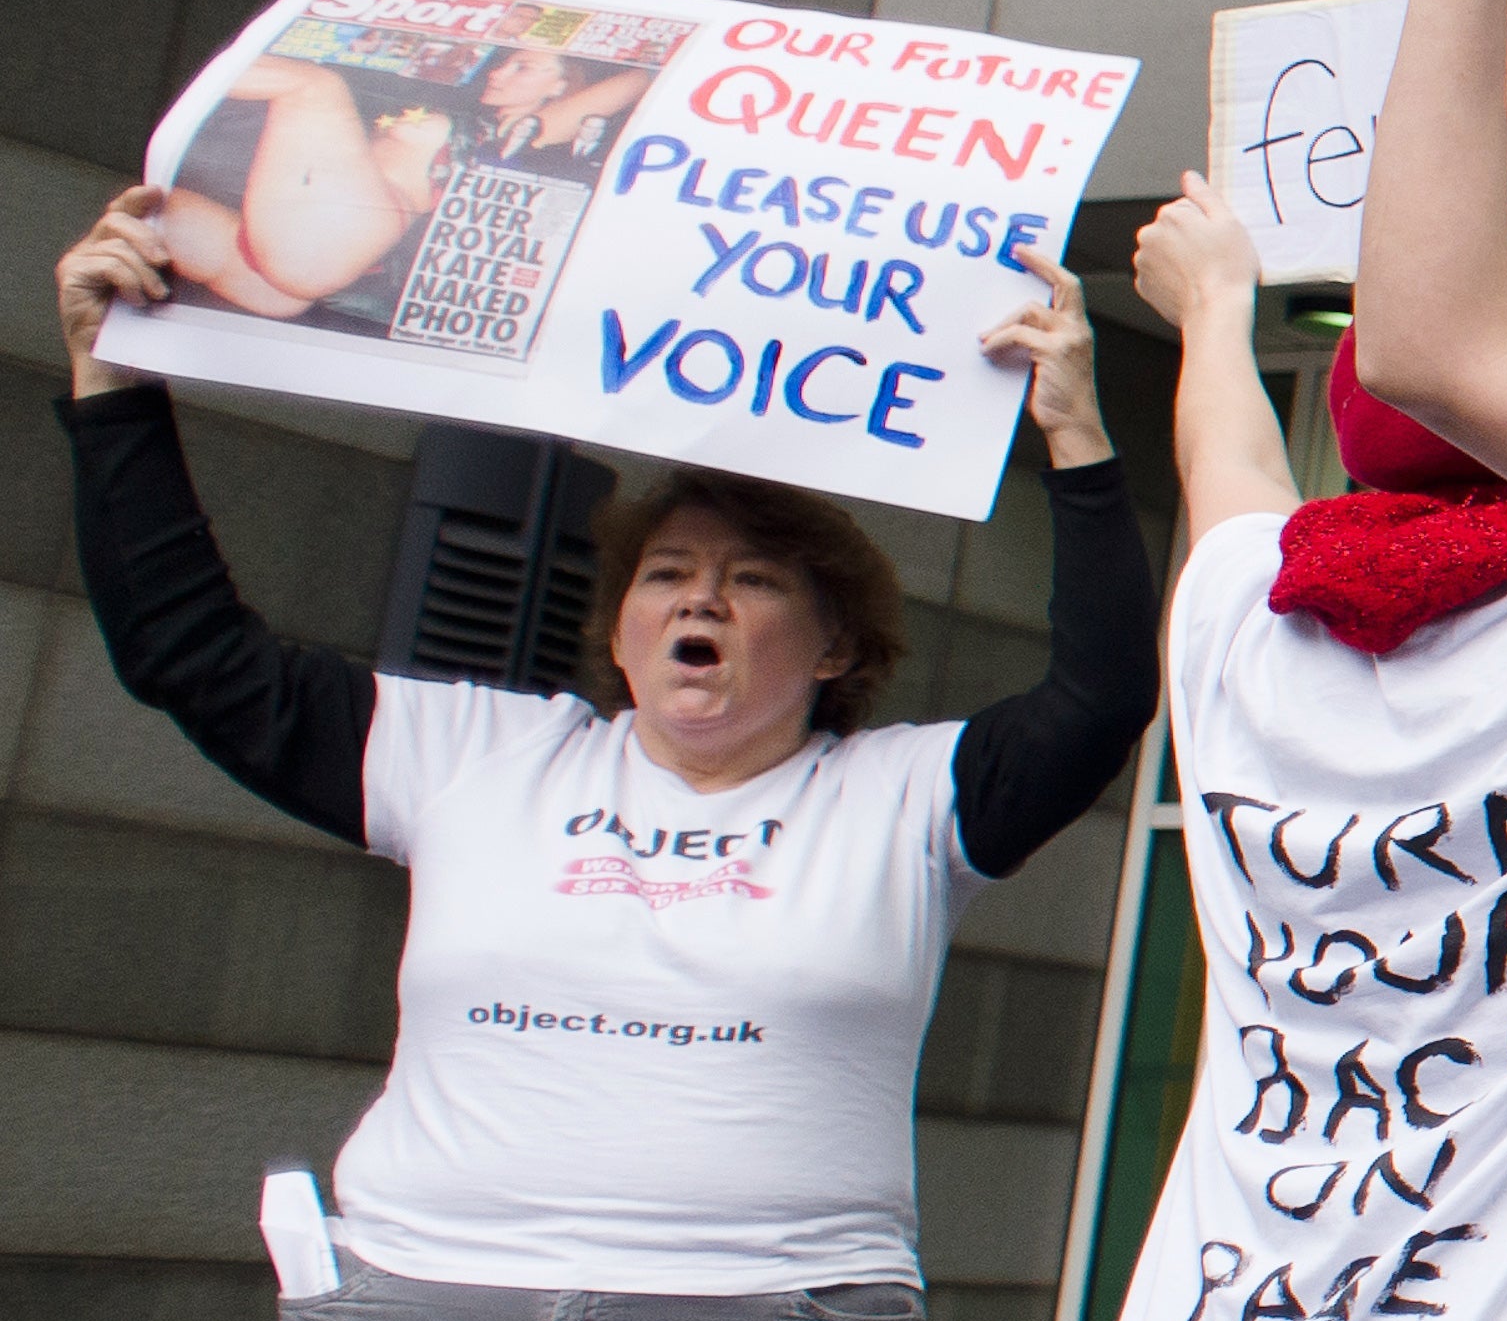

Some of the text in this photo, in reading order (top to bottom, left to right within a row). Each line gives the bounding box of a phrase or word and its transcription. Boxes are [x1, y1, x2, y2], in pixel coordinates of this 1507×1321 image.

[723, 18, 875, 67] OUR
[891, 40, 1126, 110] FUTURE
[451, 170, 544, 208] FURY
[614, 134, 1050, 273] PLEASE USE
[441, 196, 532, 234] OVER
[418, 245, 511, 286] KATE
[428, 220, 544, 266] ROYAL
[408, 274, 530, 317] NAKED
[691, 222, 925, 334] YOUR
[398, 300, 519, 343] PHOTO
[602, 308, 945, 448] VOICE
[468, 1002, 766, 1047] object.org.uk
[1266, 1133, 1457, 1220] ON
